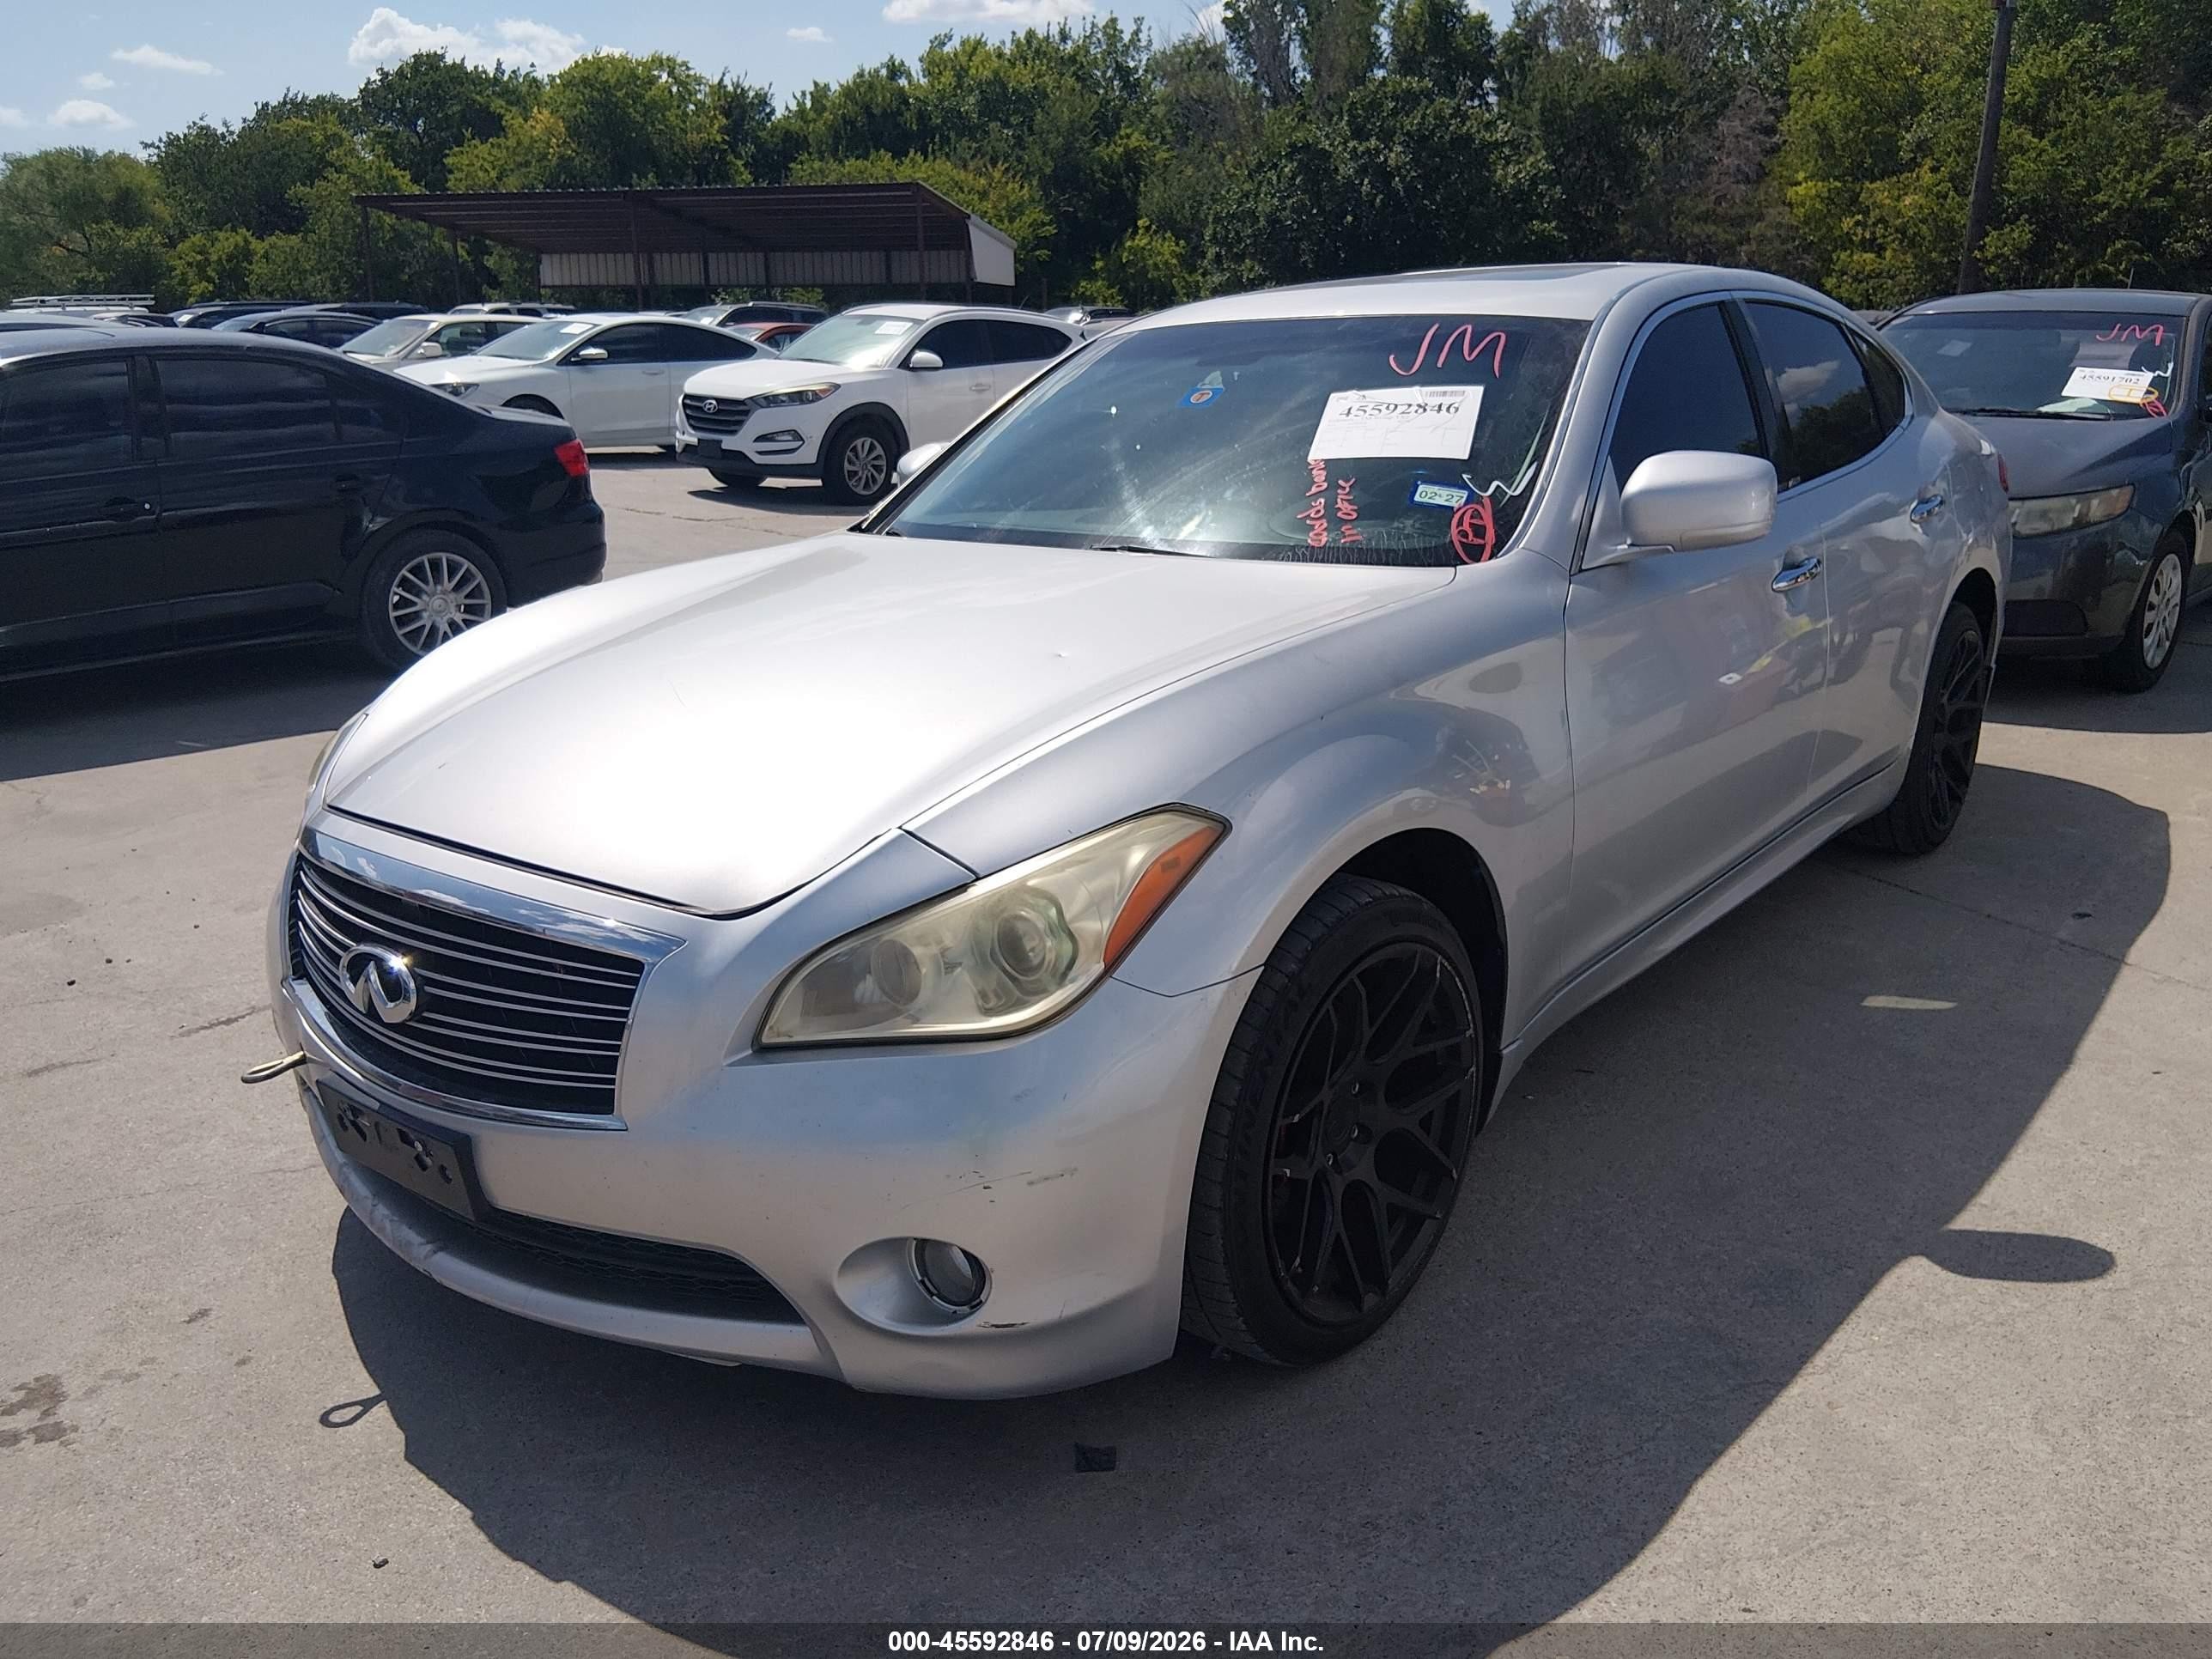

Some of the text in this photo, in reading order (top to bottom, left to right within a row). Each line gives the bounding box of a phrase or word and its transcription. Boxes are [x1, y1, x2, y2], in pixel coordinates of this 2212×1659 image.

[2095, 323, 2165, 347] JM
[1389, 322, 1507, 379] JM
[1339, 401, 1460, 418] 45592846
